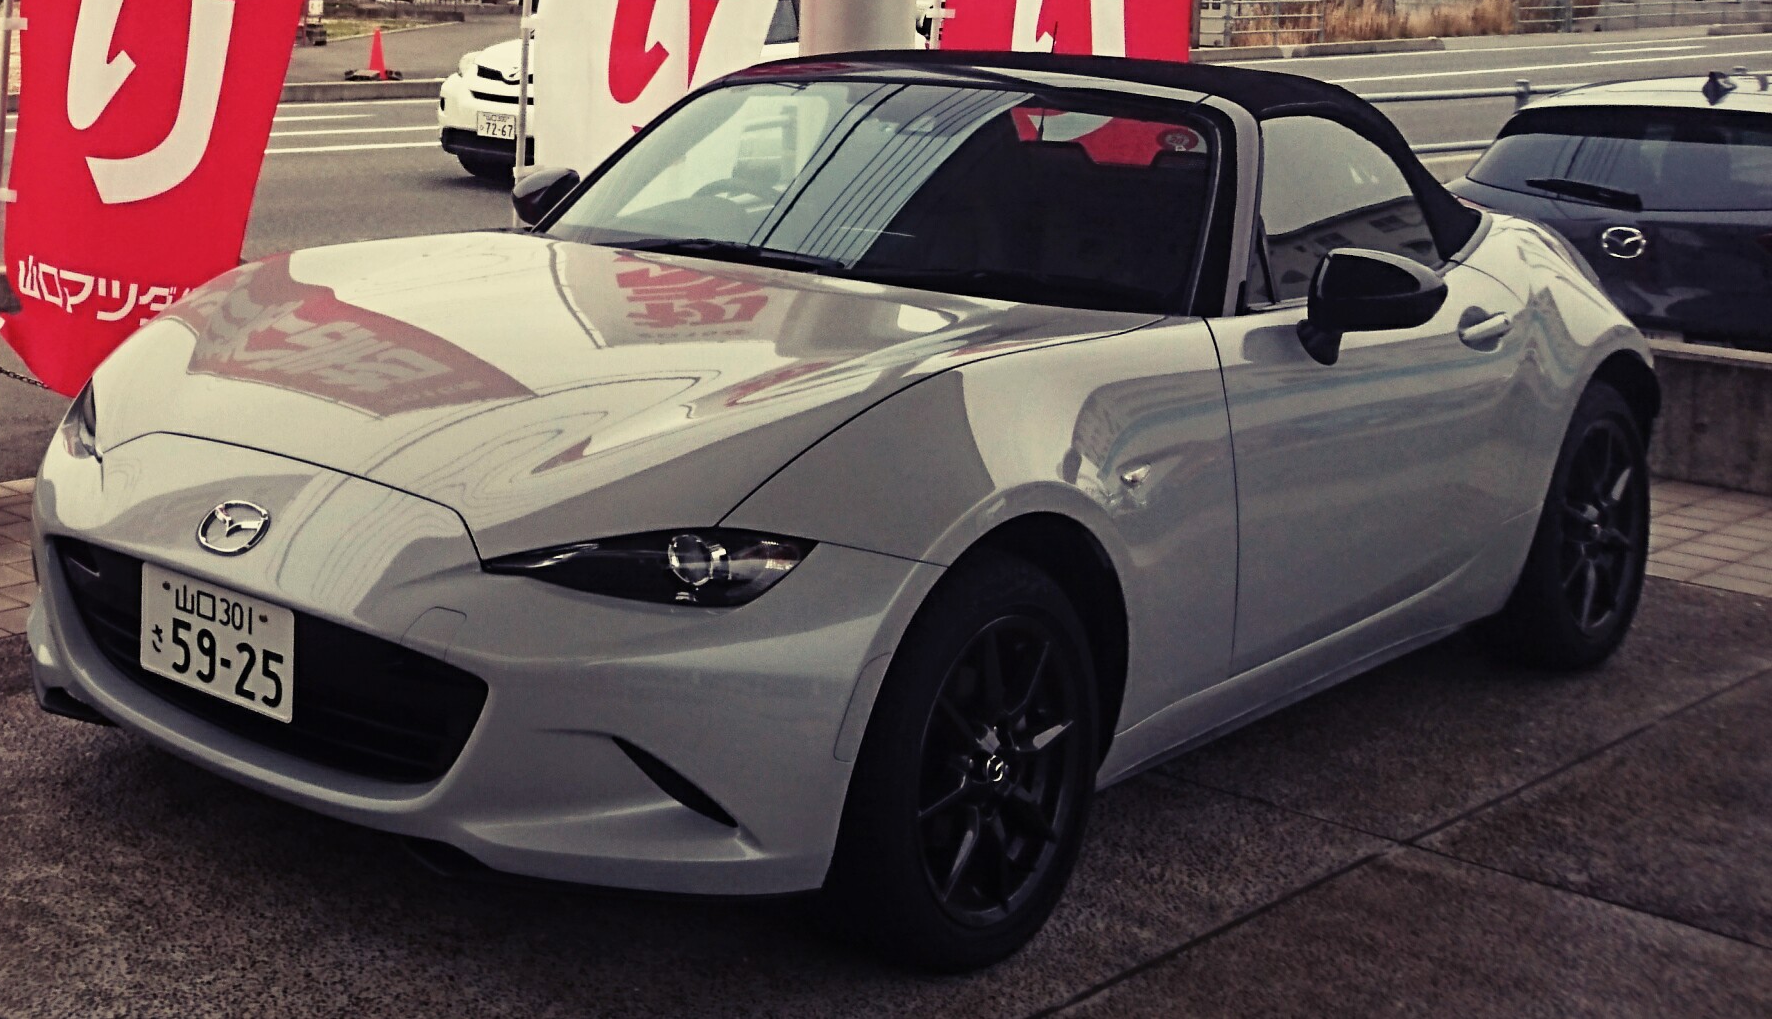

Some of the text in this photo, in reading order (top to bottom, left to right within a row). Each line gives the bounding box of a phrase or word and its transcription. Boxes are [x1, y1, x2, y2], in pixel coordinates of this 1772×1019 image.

[175, 584, 254, 635] 山口301
[152, 617, 285, 709] さ 59-25
